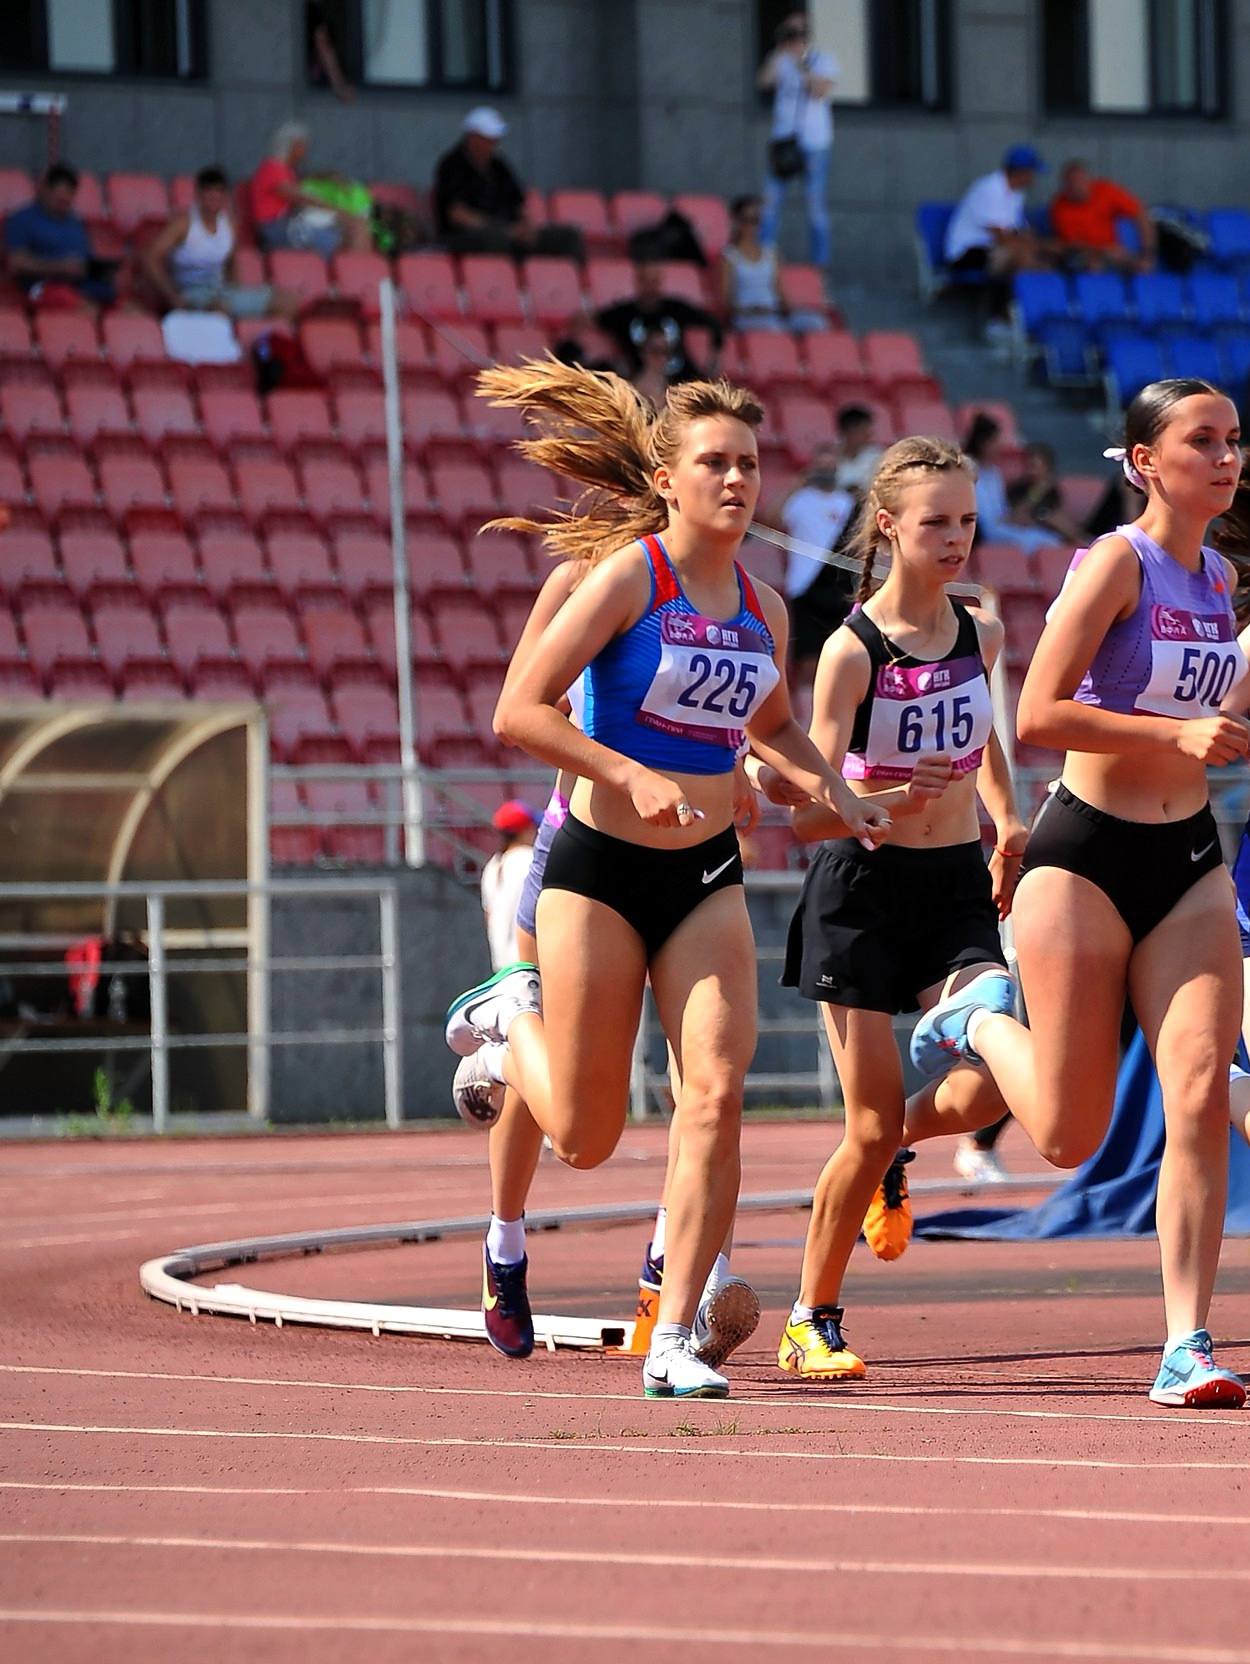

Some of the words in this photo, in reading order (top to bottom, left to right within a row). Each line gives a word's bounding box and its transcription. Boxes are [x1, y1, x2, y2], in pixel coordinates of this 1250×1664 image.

[677, 654, 758, 718] 225
[1173, 648, 1236, 707] 500
[897, 695, 974, 753] 615
